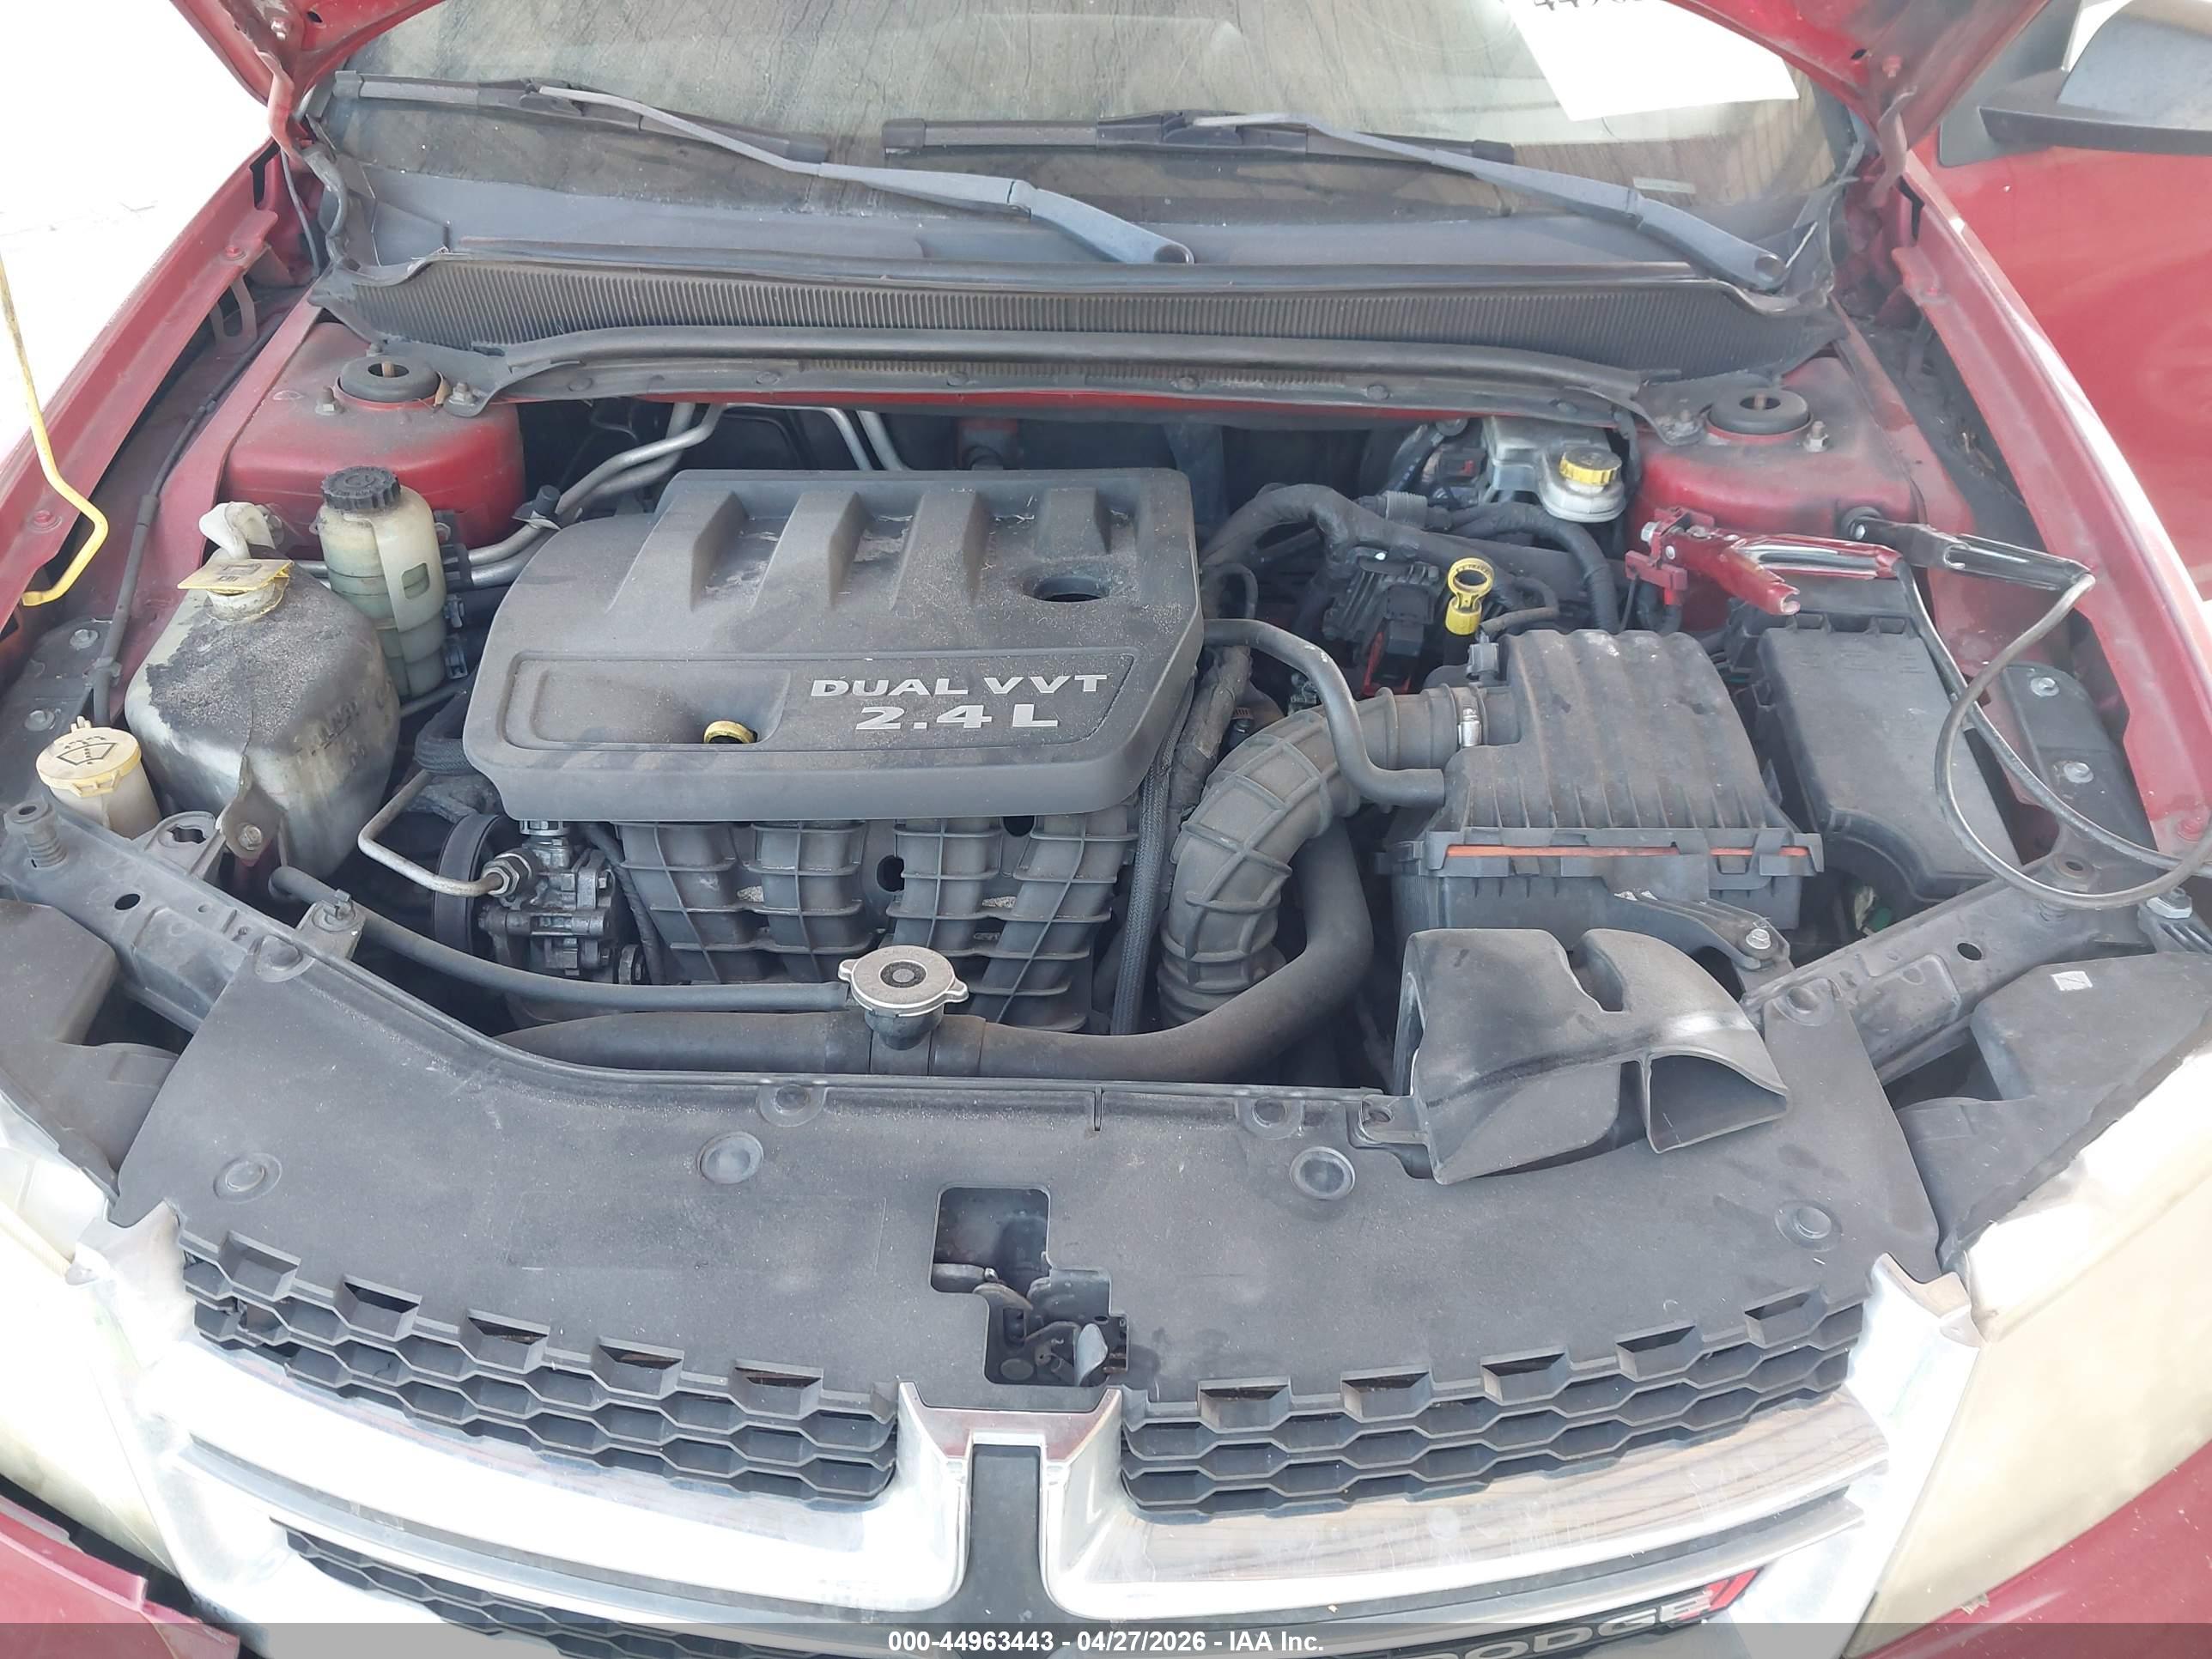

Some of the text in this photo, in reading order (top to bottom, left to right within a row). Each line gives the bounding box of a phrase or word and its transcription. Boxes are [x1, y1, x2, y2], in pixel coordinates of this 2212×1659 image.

[811, 674, 1108, 697] DUAL VVT
[1401, 1589, 1714, 1659] ODGE
